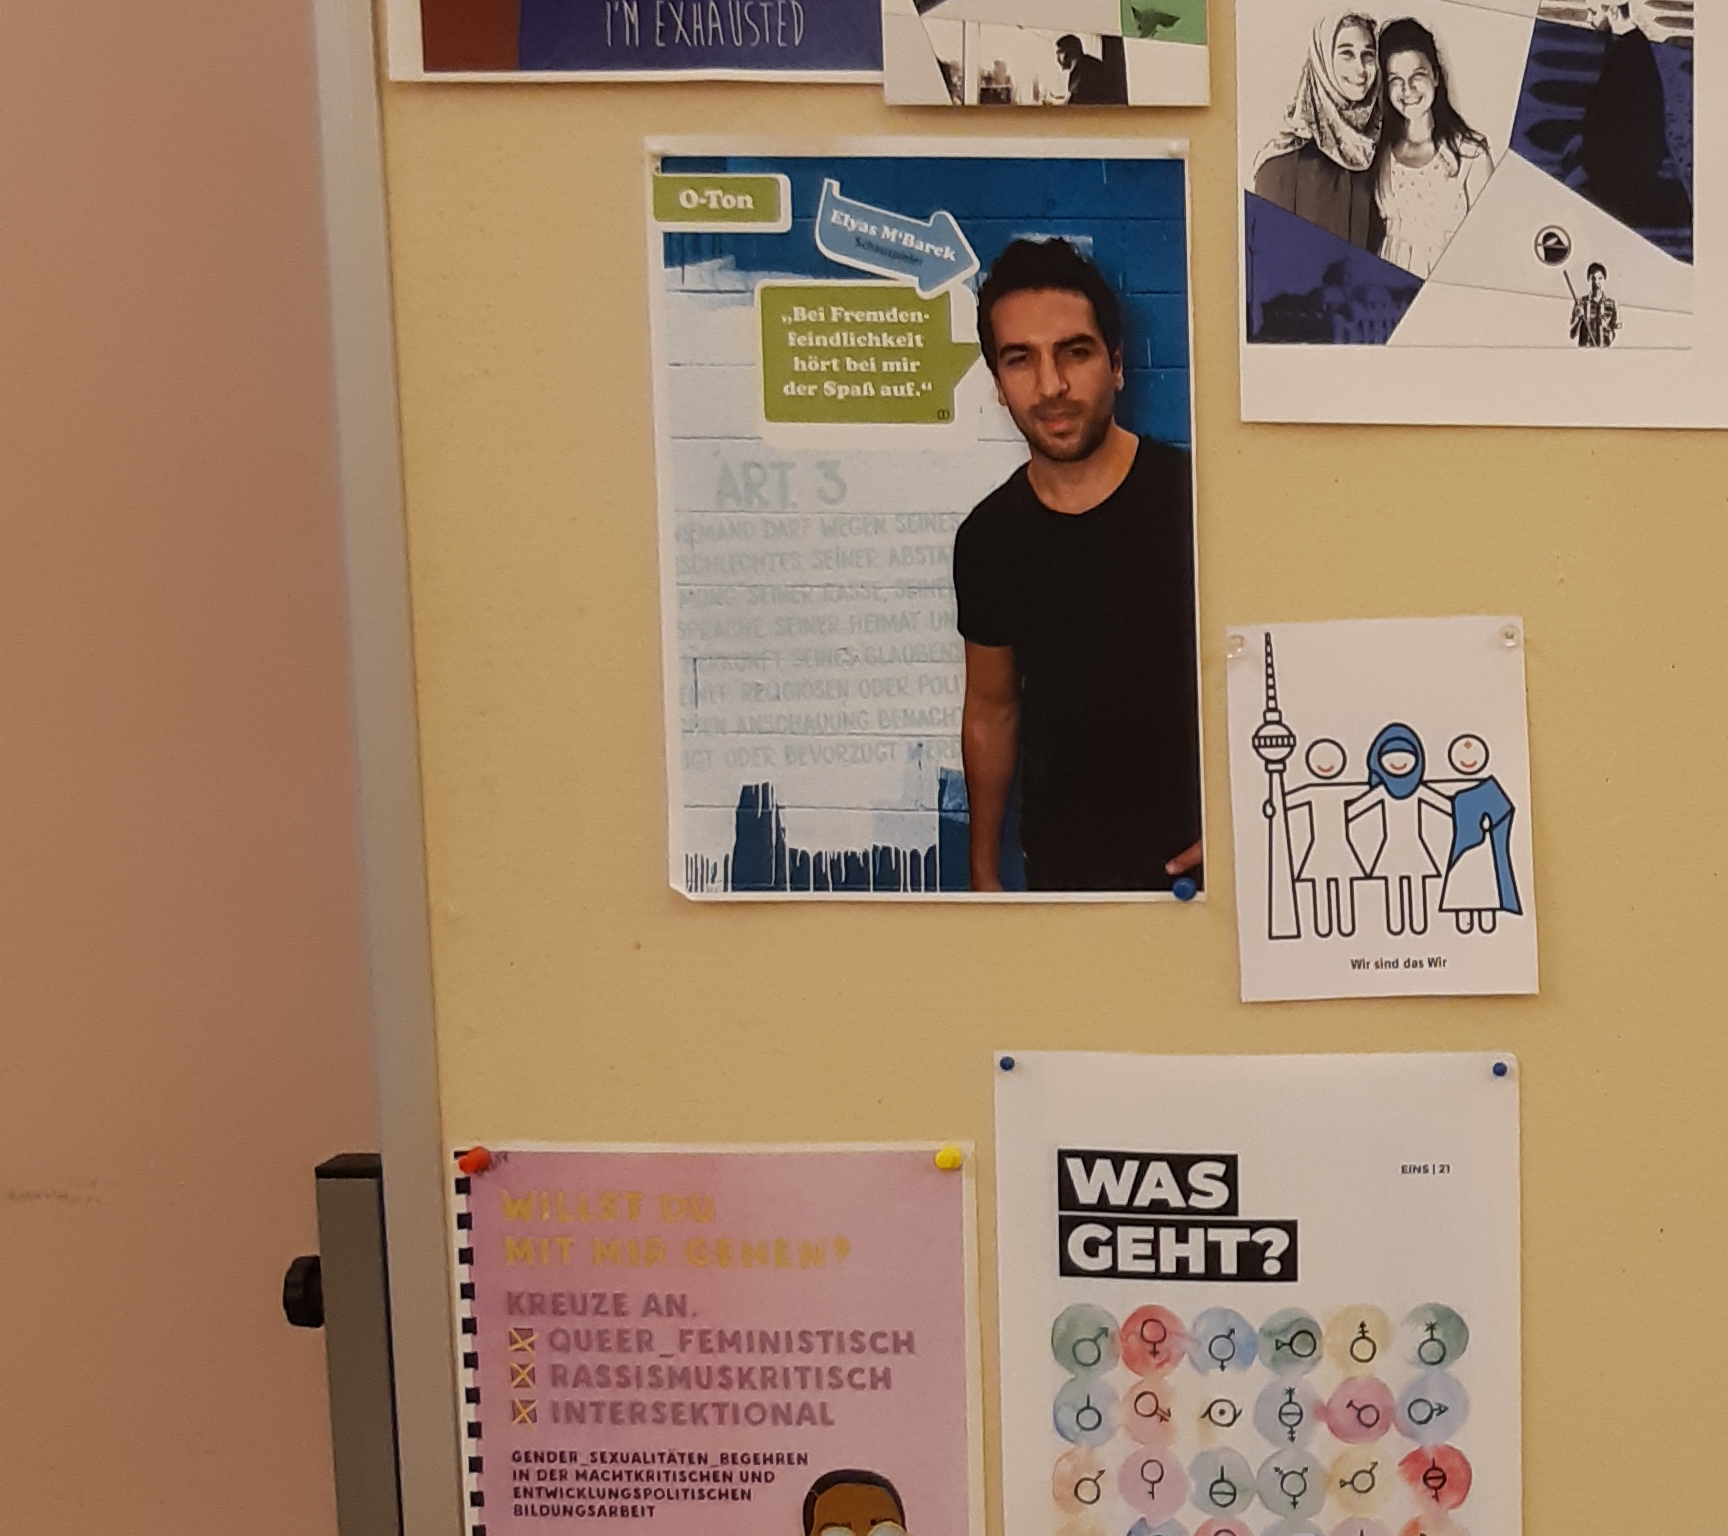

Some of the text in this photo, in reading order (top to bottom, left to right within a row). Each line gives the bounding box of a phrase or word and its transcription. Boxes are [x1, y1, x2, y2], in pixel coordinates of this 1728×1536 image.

[606, 0, 804, 47] I'M EXHAUSTED
[679, 189, 754, 210] O-Ton
[831, 306, 930, 323] Fremden-
[788, 332, 923, 348] feindlichkeit
[794, 356, 921, 372] hört bei mir
[783, 381, 817, 396] der
[823, 381, 874, 399] Spaß
[1351, 957, 1447, 970] Wir sind das Wir
[1401, 1165, 1429, 1174] EINS
[1066, 1157, 1230, 1209] WAS
[1067, 1223, 1289, 1274] GEHT?
[507, 1292, 629, 1318] KREUZE
[550, 1329, 916, 1358] QUEER_FEMINISTISCH
[551, 1367, 892, 1391] RASSISMUSKRITISCH
[552, 1402, 835, 1426] INTERSEKTIONAL
